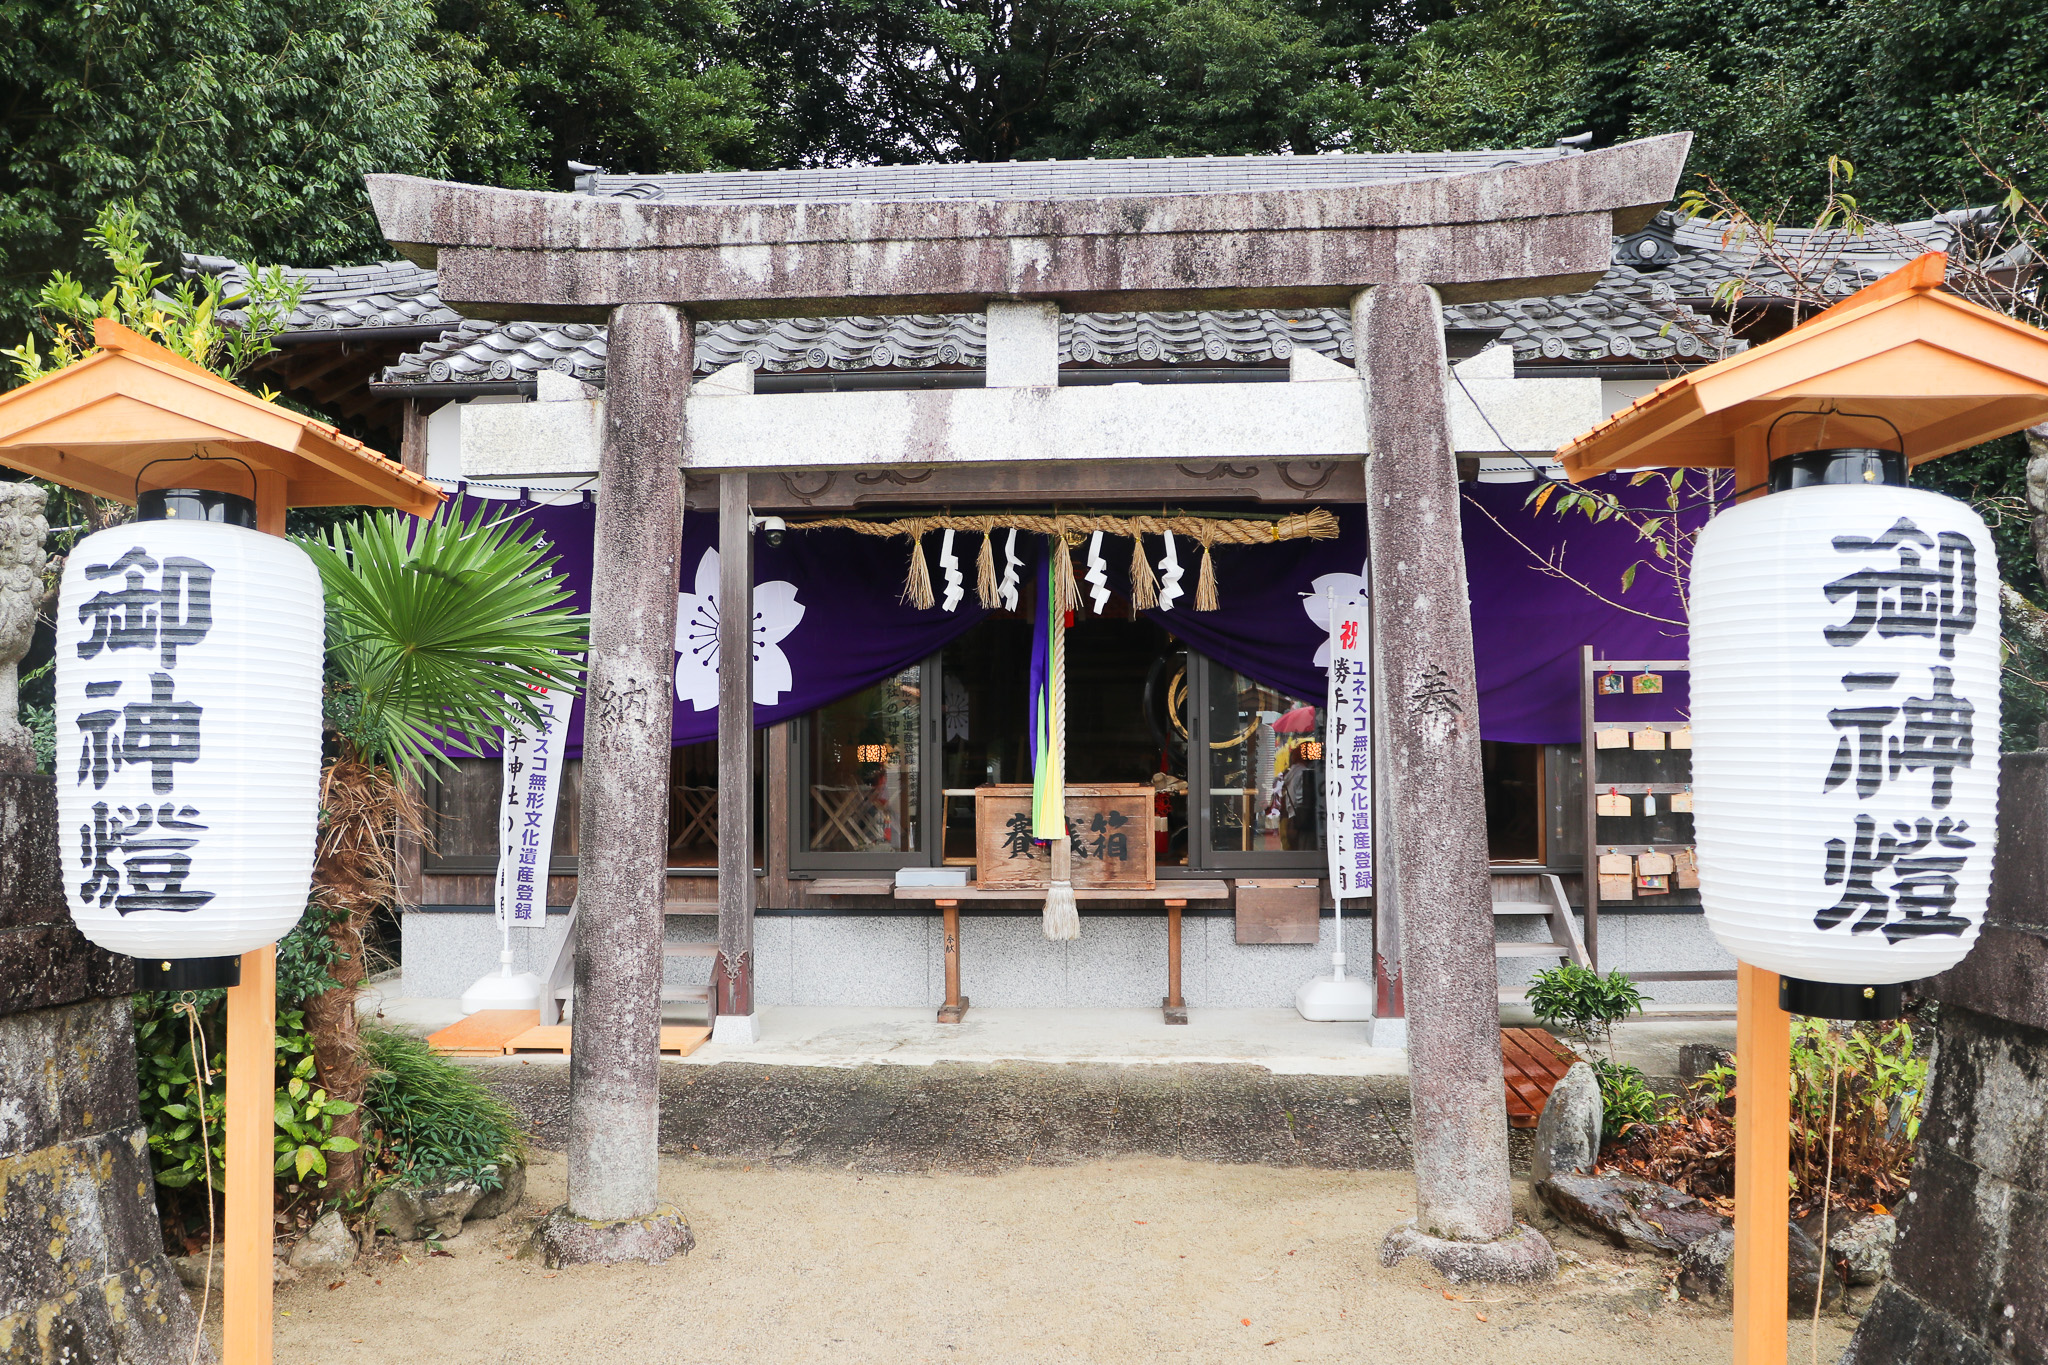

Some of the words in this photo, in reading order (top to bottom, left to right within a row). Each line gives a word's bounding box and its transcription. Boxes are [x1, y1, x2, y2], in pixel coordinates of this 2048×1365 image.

[77, 546, 216, 918] 御神燈
[1339, 620, 1359, 650] 祝
[1351, 660, 1373, 890] ユネスコ無形文化遺産登録
[1814, 515, 1978, 945] 御神燈
